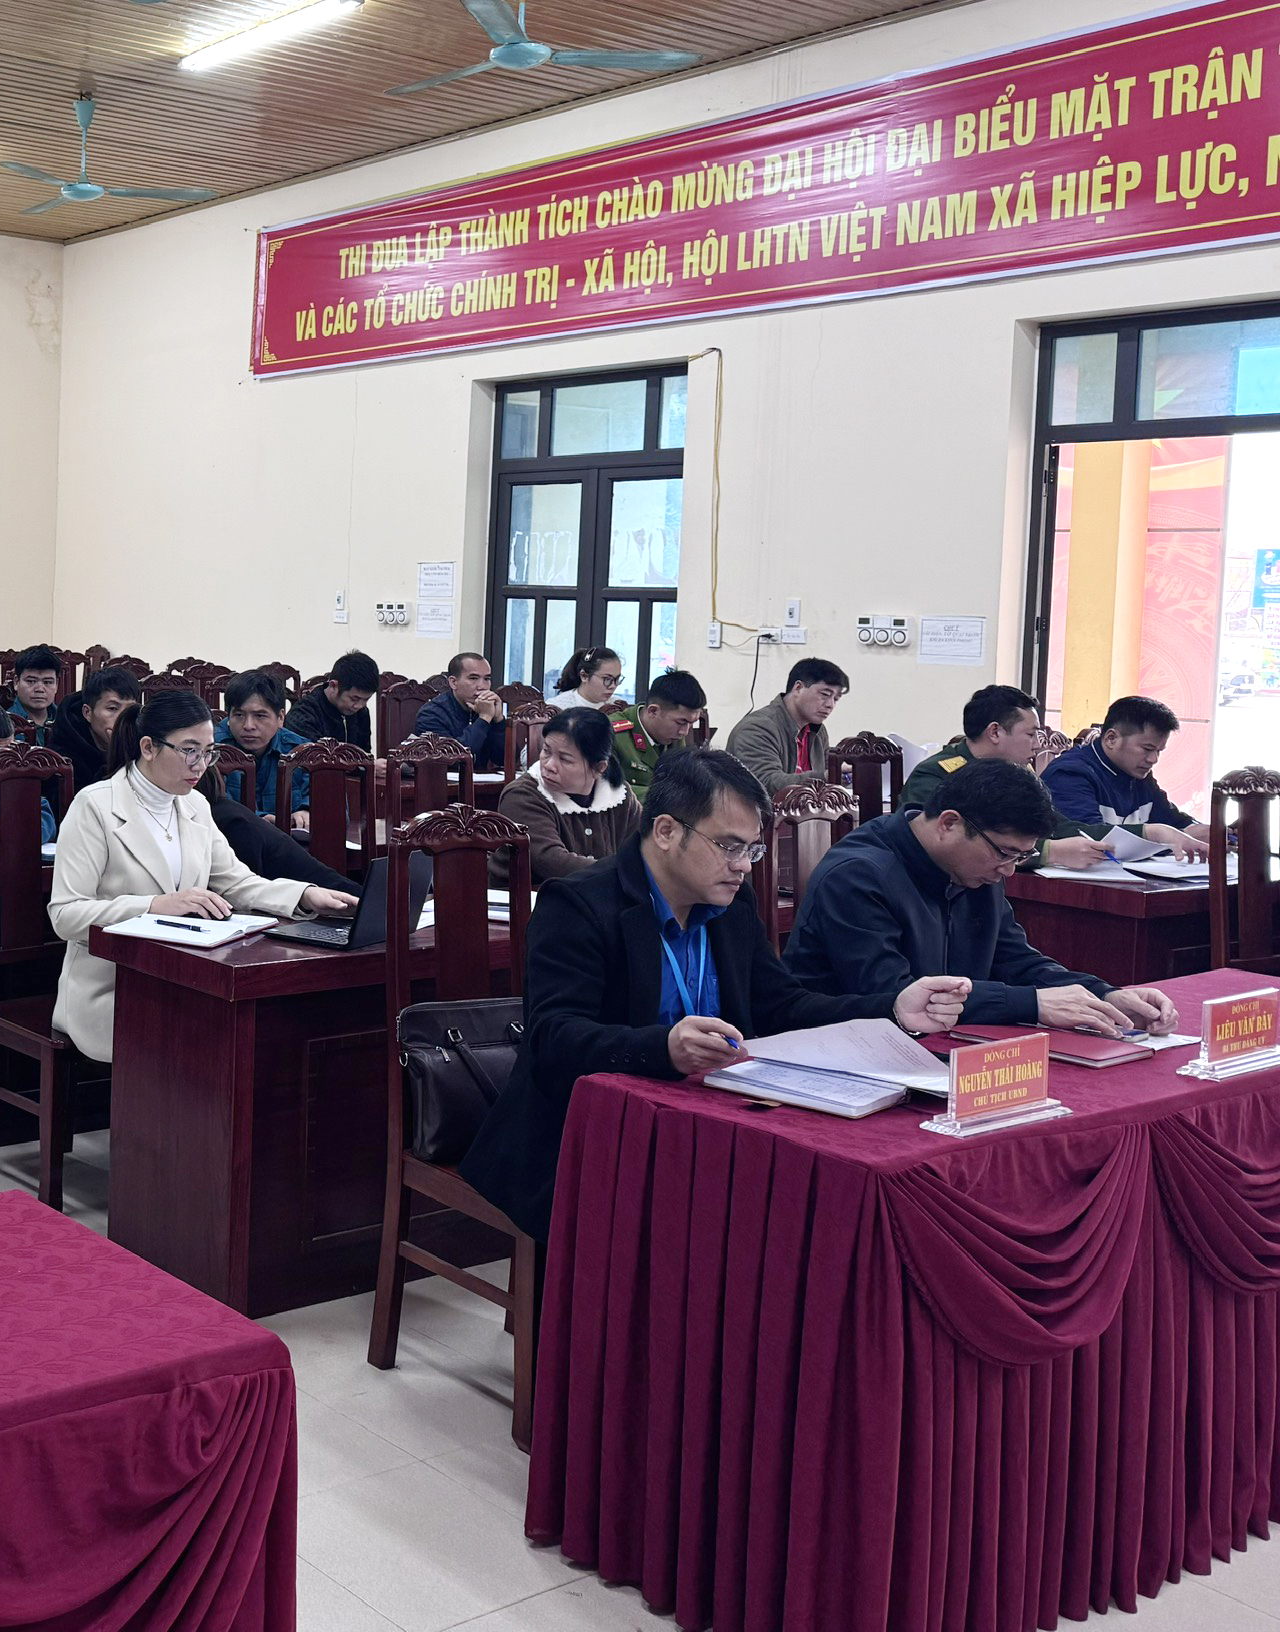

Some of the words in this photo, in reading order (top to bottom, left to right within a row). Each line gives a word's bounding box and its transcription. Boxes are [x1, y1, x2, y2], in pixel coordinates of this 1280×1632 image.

[338, 246, 368, 279] THI
[371, 240, 407, 273] ĐUA
[415, 222, 452, 270] LẬP
[458, 207, 530, 254] THÀNH
[537, 192, 588, 239] TÍCH
[595, 177, 663, 229] CHÀO
[670, 160, 753, 214] MỪNG
[763, 149, 814, 200] ĐẠI
[823, 128, 876, 184] HỘI
[885, 119, 943, 179] ĐẠI
[954, 84, 1039, 159] BIỂU
[1049, 72, 1137, 141] MẶT
[1149, 47, 1263, 120] TRẬN
[295, 303, 317, 342] VÀ
[322, 296, 358, 336] CÁC
[364, 283, 389, 331] TỔ
[392, 280, 444, 327] CHỨC
[451, 270, 518, 318] CHÍNH
[524, 264, 561, 310] TRỊ
[582, 249, 617, 296] XÃ
[622, 244, 673, 294] HỘI,
[682, 228, 730, 285] HỘI
[736, 217, 811, 269] LHTN
[821, 198, 889, 263] VIỆT
[896, 189, 977, 246] NAM
[988, 169, 1039, 230] XÃ
[1050, 153, 1142, 224] HIỆP
[1155, 138, 1249, 211] LỰC,
[1238, 1015, 1255, 1036] VĂN
[984, 1049, 1006, 1063] ĐỒNG
[1006, 1045, 1020, 1059] CHÍ
[959, 1065, 993, 1094] NGUYỄN
[994, 1063, 1014, 1087] THÁI
[1015, 1059, 1043, 1082] HOÀNG
[973, 1093, 989, 1107] CHỦ
[990, 1092, 1007, 1104] TỊCH
